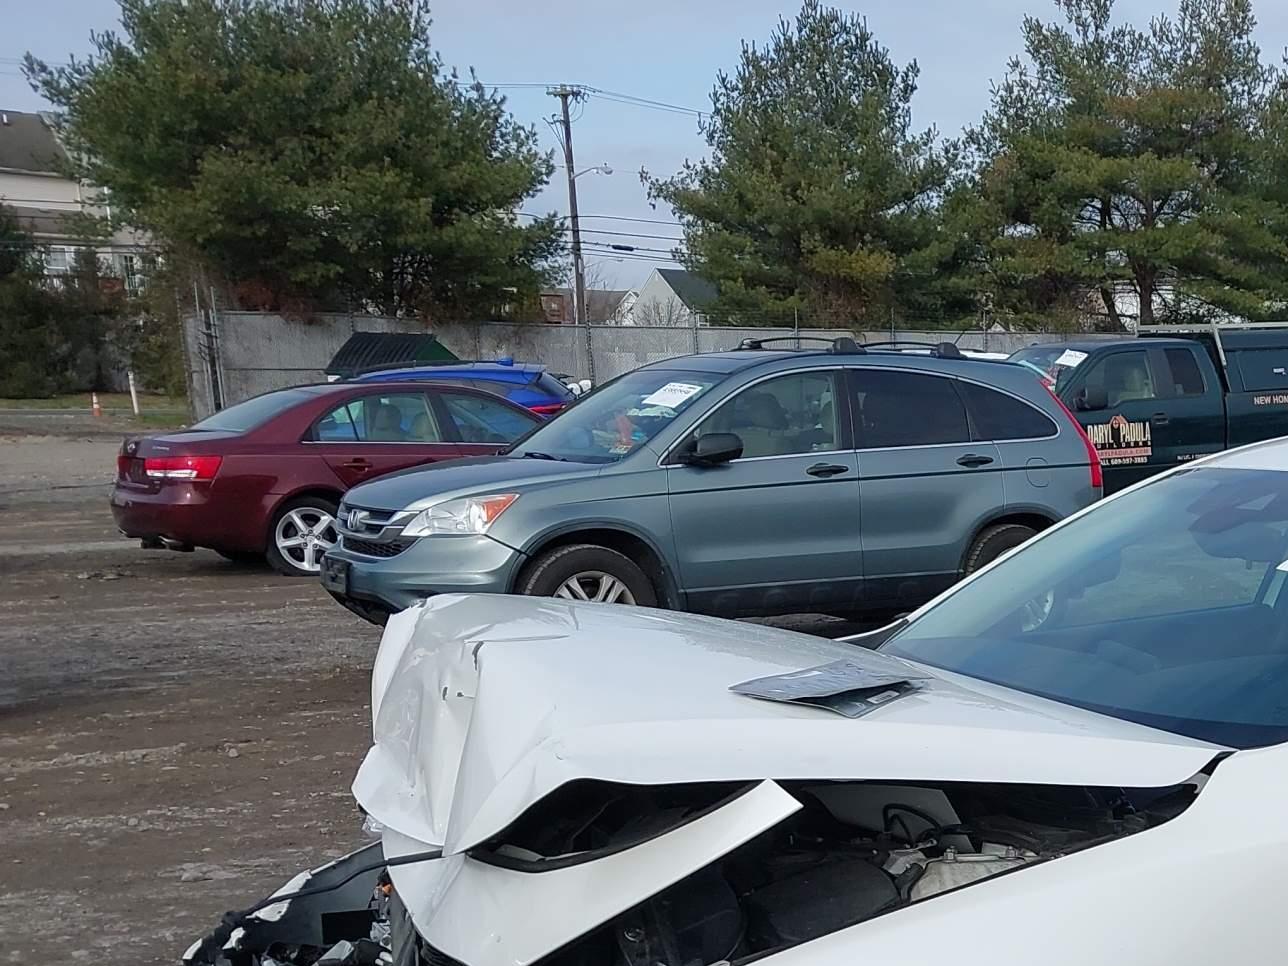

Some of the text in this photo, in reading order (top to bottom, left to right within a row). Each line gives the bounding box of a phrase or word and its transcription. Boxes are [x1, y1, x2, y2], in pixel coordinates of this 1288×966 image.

[1254, 396, 1271, 405] NEW
[1087, 422, 1151, 443] DARYL PADULA
